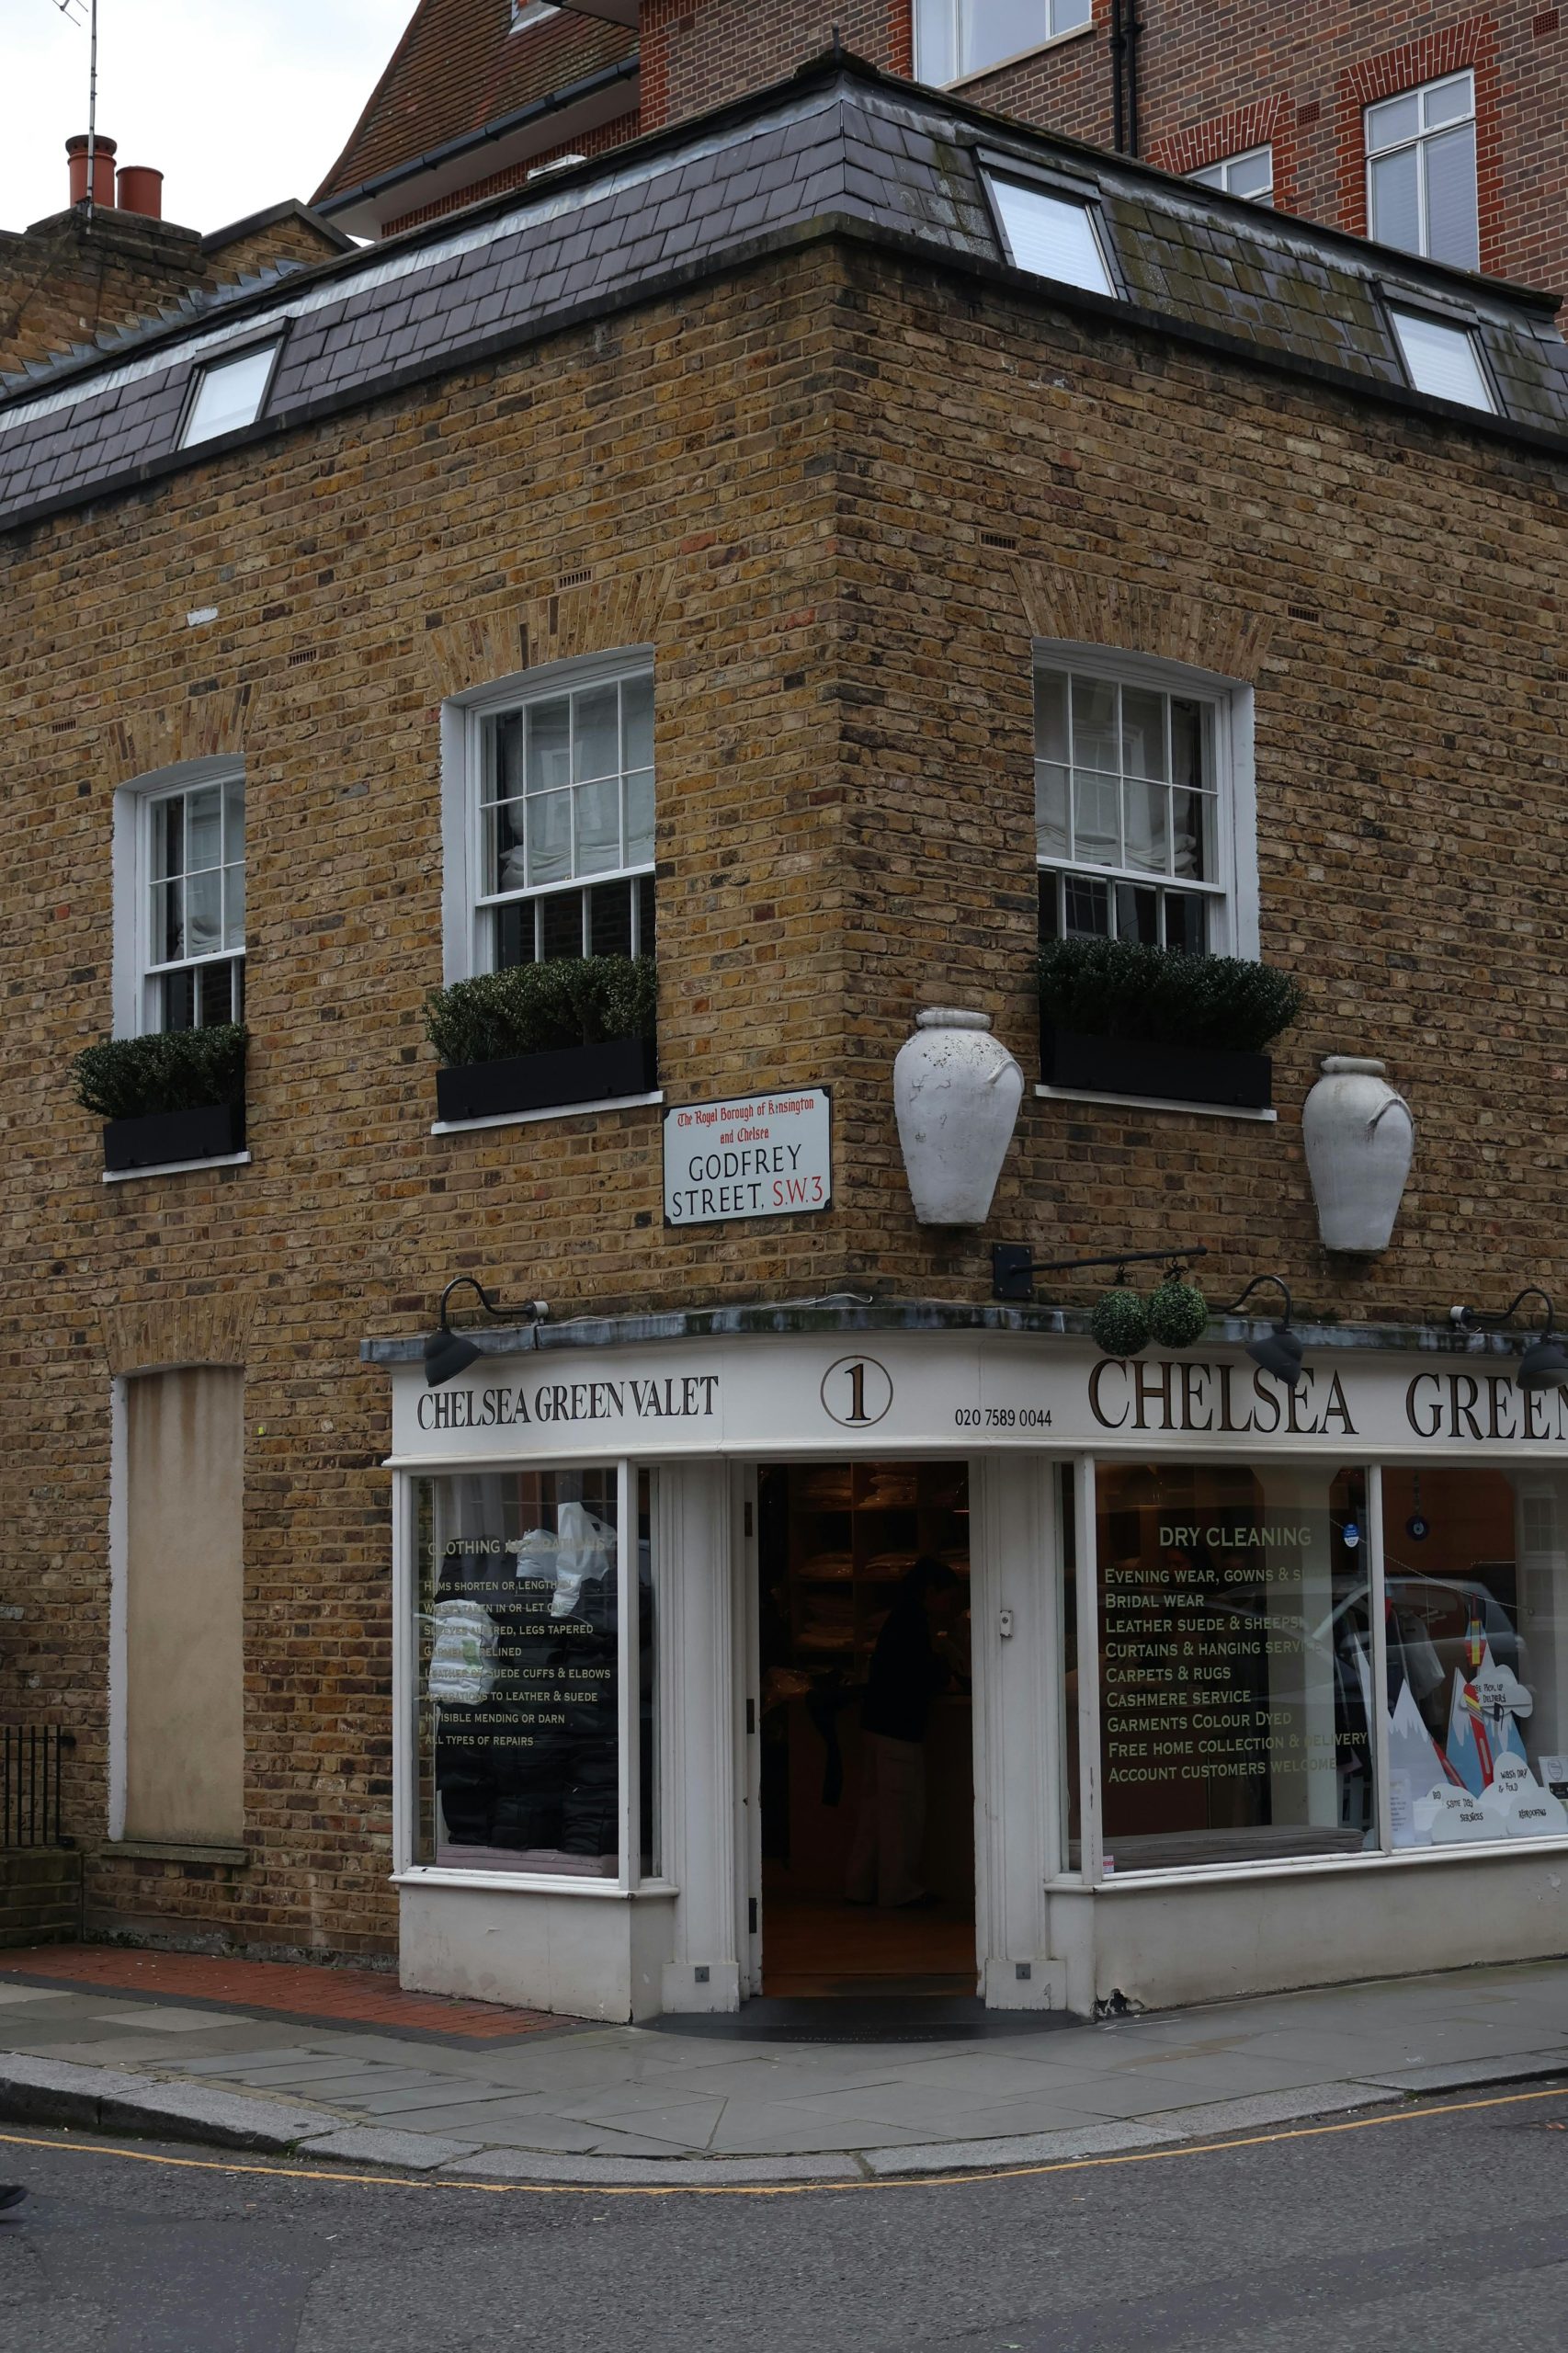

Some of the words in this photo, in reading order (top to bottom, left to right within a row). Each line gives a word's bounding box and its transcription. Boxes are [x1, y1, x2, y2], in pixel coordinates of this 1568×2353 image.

[677, 1112, 693, 1127] The
[694, 1108, 718, 1128] Royal
[721, 1104, 754, 1121] Borough
[756, 1102, 767, 1116] of
[720, 1129, 733, 1144] and
[737, 1126, 769, 1142] Chelsea
[689, 1143, 801, 1181] GODFREY
[672, 1182, 765, 1218] STREET,
[772, 1176, 824, 1207] S.W.3
[844, 1363, 871, 1420] 1
[1087, 1358, 1360, 1436] CHELSEA
[416, 1388, 530, 1430] CHELSEA
[534, 1381, 625, 1421] GREEN
[629, 1375, 719, 1417] VALET
[955, 1408, 981, 1427] 020
[984, 1408, 1016, 1427] 7589
[1019, 1409, 1052, 1427] 0044
[1159, 1527, 1199, 1547] DRY
[1206, 1527, 1312, 1547] CLEANING
[428, 1540, 500, 1556] CLOTHING
[1105, 1568, 1170, 1584] EVENING
[1175, 1570, 1220, 1586] WEAR,
[1224, 1569, 1274, 1582] GOWNS
[1278, 1567, 1289, 1581] &
[455, 1581, 498, 1591] SHORTEN
[502, 1581, 516, 1591] OR
[496, 1603, 506, 1613] IN
[509, 1603, 523, 1613] OR
[526, 1603, 544, 1613] LET
[1106, 1594, 1159, 1608] BRIDAL
[1164, 1595, 1205, 1608] WEAR
[519, 1626, 545, 1635] LEGS
[548, 1625, 594, 1635] TAPERED
[1106, 1618, 1173, 1633] LEATHER
[1177, 1618, 1225, 1631] SUEDE
[1229, 1616, 1240, 1631] &
[481, 1647, 522, 1657] RELINED
[1106, 1643, 1178, 1658] CURTAINS
[1183, 1641, 1194, 1656] &
[1199, 1642, 1261, 1655] HANGING
[1266, 1641, 1323, 1654] SERVIE
[488, 1668, 519, 1679] SUEDE
[523, 1668, 555, 1679] CUFFS
[558, 1667, 566, 1678] &
[569, 1668, 611, 1679] ELBOWS
[1106, 1667, 1173, 1683] CARPETS
[1178, 1665, 1188, 1680] &
[1194, 1666, 1232, 1680] RUGS
[492, 1691, 503, 1701] TO
[506, 1691, 551, 1701] LEATHER
[553, 1689, 562, 1701] &
[564, 1692, 597, 1702] SUEDE
[1107, 1692, 1187, 1708] CASHMERE
[1193, 1690, 1251, 1704] SERVICE
[426, 1712, 472, 1722] INVISIBLE
[474, 1713, 519, 1723] MENDING
[521, 1713, 535, 1723] OR
[538, 1714, 565, 1724] DARN
[1108, 1716, 1187, 1733] GARMENTS
[1192, 1711, 1250, 1728] COLOUR
[1256, 1711, 1292, 1726] DYED
[425, 1735, 444, 1745] ALL
[446, 1735, 475, 1745] TYPES
[477, 1735, 489, 1745] OF
[493, 1736, 534, 1746] REPAIRS
[1108, 1742, 1147, 1757] FREE
[1153, 1741, 1194, 1755] HOME
[1199, 1735, 1284, 1753] COLLECTION
[1289, 1733, 1300, 1748] &
[1108, 1767, 1176, 1783] ACCOUNT
[1181, 1762, 1266, 1779] CUSTOMERS
[1270, 1757, 1337, 1773] WELCOME
